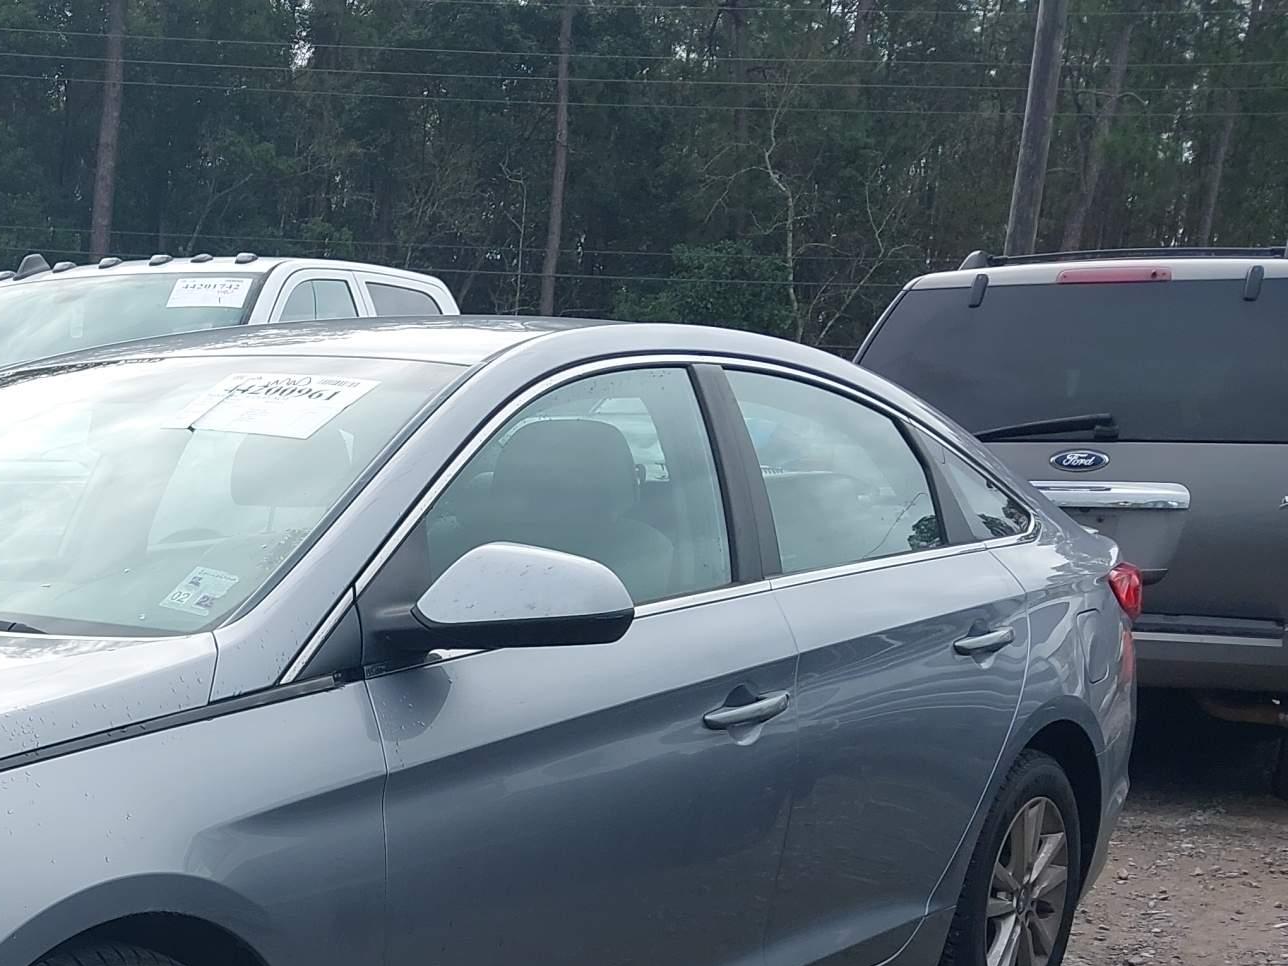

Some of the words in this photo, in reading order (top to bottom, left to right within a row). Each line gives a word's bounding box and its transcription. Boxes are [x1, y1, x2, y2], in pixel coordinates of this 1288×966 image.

[223, 384, 341, 401] 44200961
[1062, 453, 1097, 466] Ford
[170, 590, 191, 603] 02
